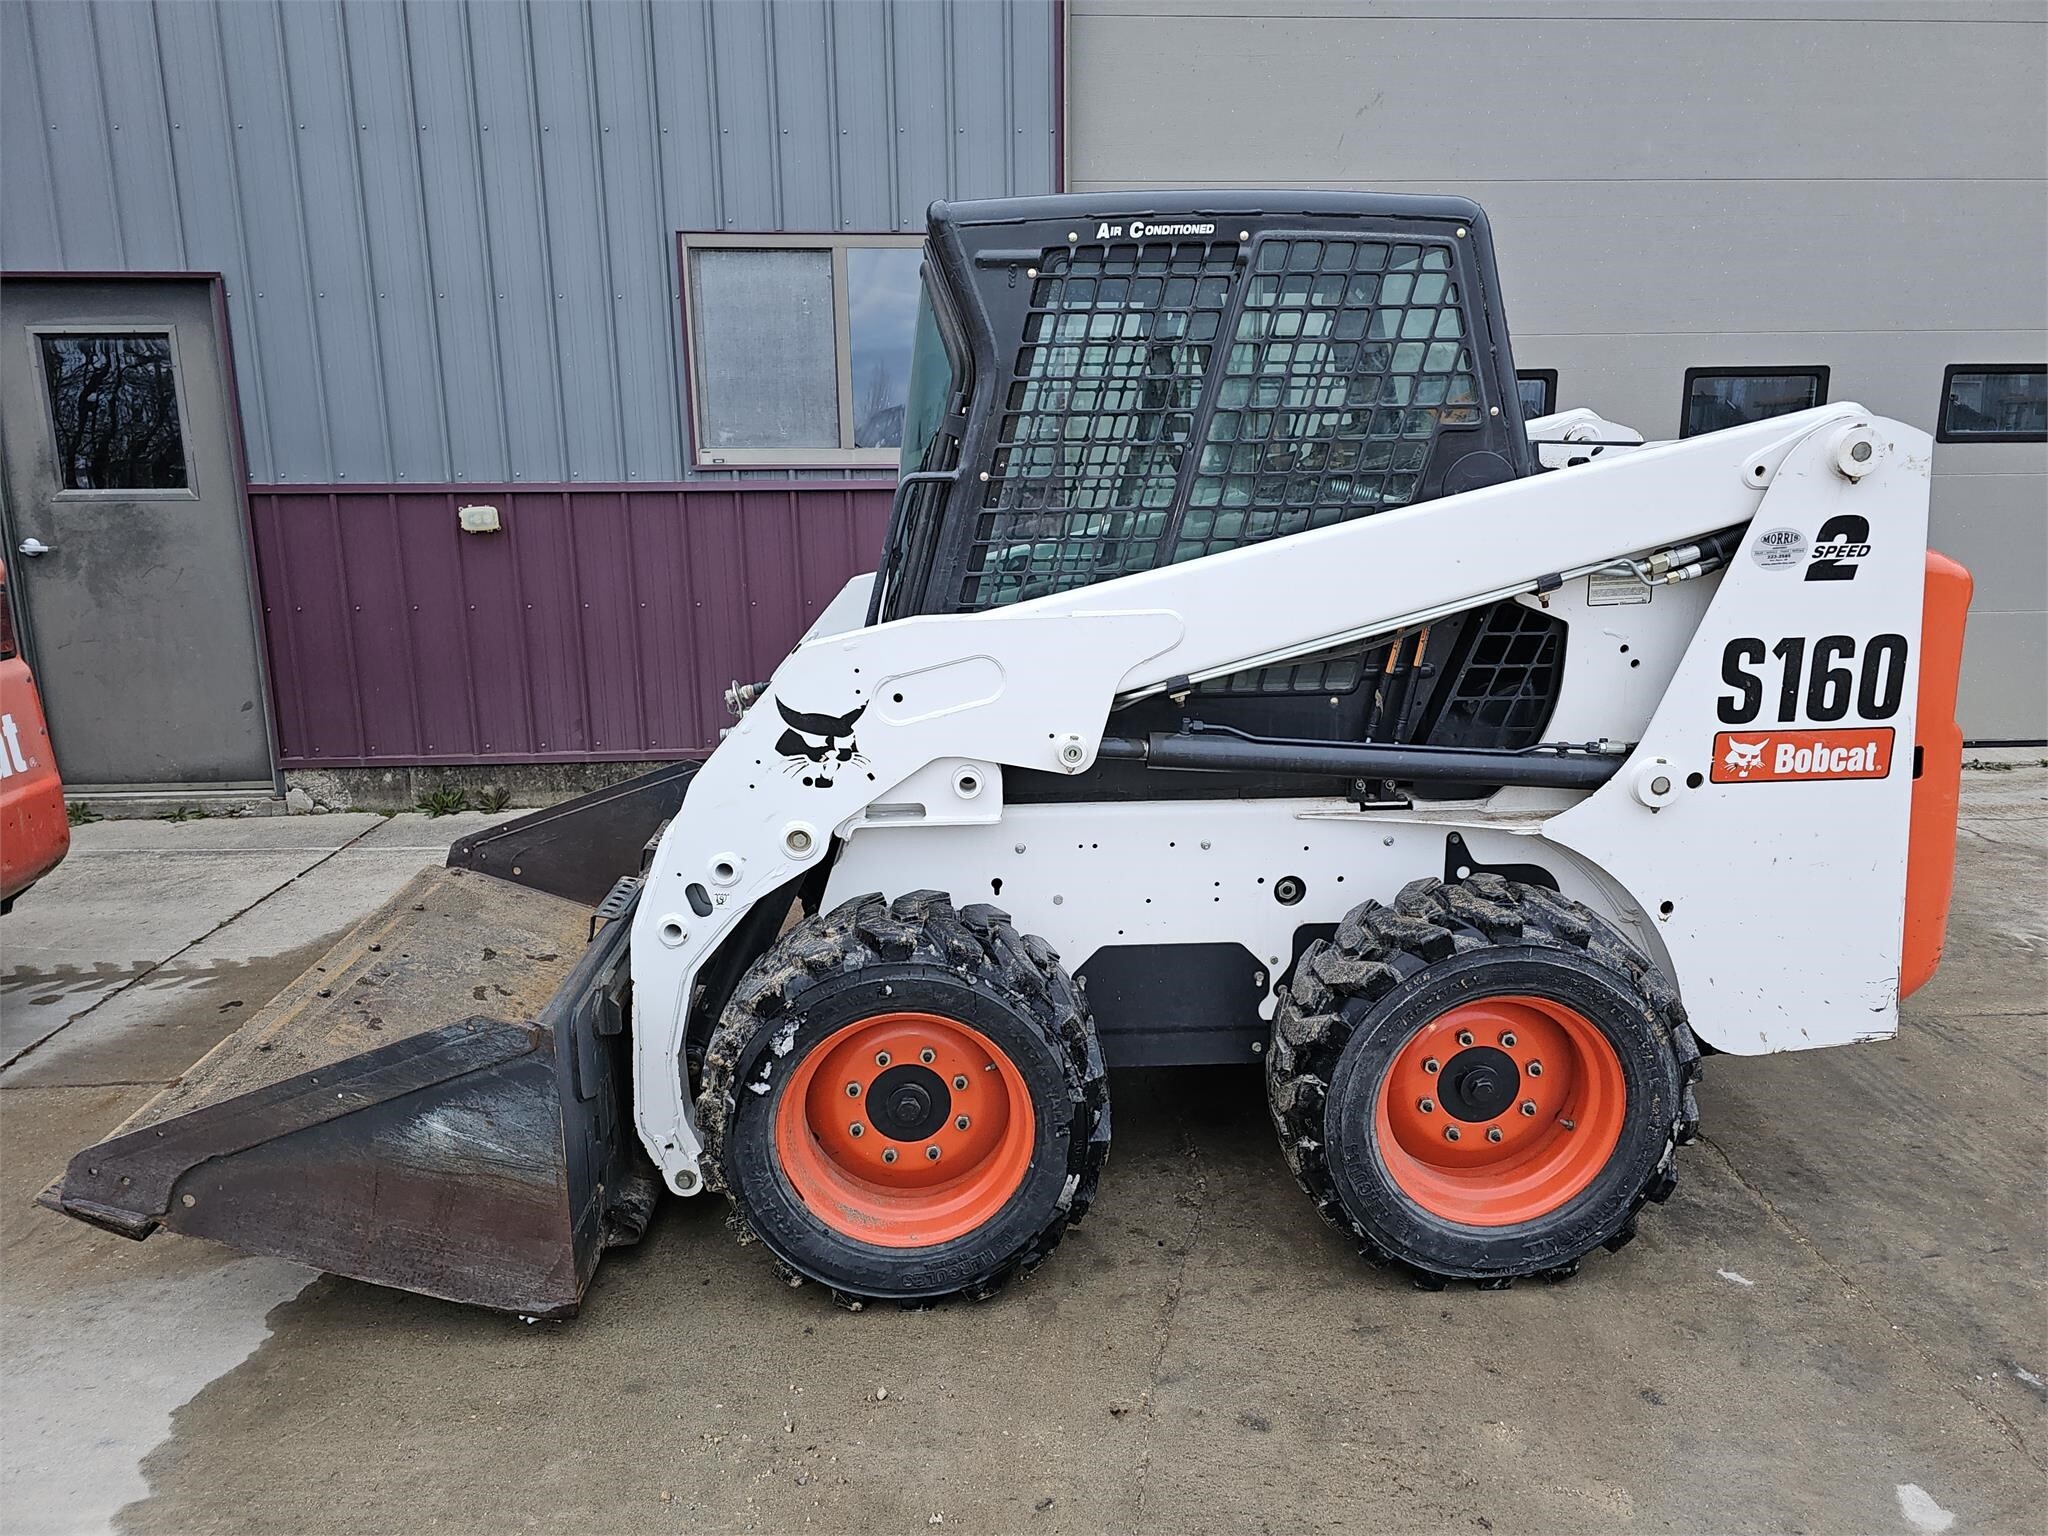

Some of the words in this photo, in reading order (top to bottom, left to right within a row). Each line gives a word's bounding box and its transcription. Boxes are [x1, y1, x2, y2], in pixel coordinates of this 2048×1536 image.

[1763, 532, 1799, 545] MORRIS
[1804, 514, 1870, 581] 2
[1811, 544, 1872, 559] SPEED
[1716, 633, 1909, 725] S160
[1773, 742, 1877, 774] Bobcat
